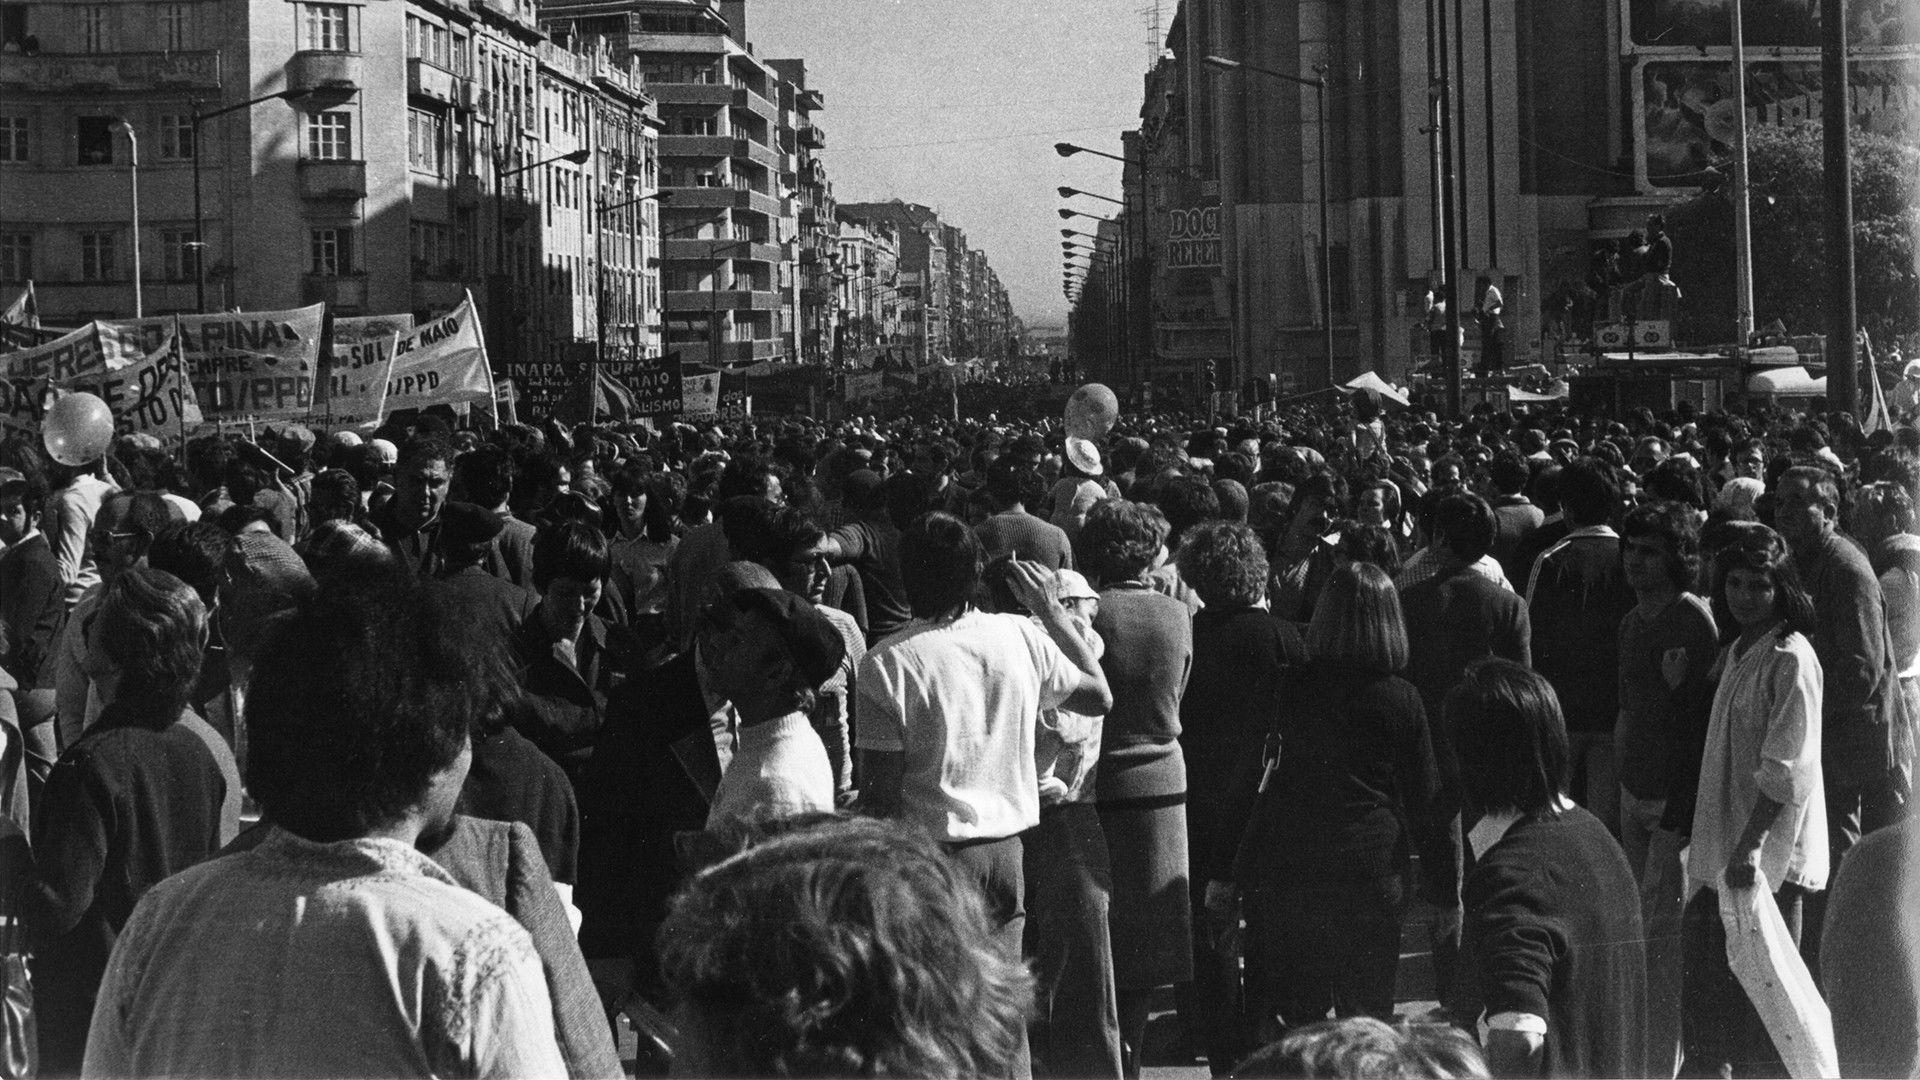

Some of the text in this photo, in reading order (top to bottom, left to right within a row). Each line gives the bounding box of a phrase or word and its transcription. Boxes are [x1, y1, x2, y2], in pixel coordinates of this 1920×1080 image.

[201, 320, 283, 352] PINA
[350, 341, 386, 369] SUL
[397, 337, 414, 356] DE
[506, 362, 565, 377] INAPA
[629, 372, 670, 388] MAIO
